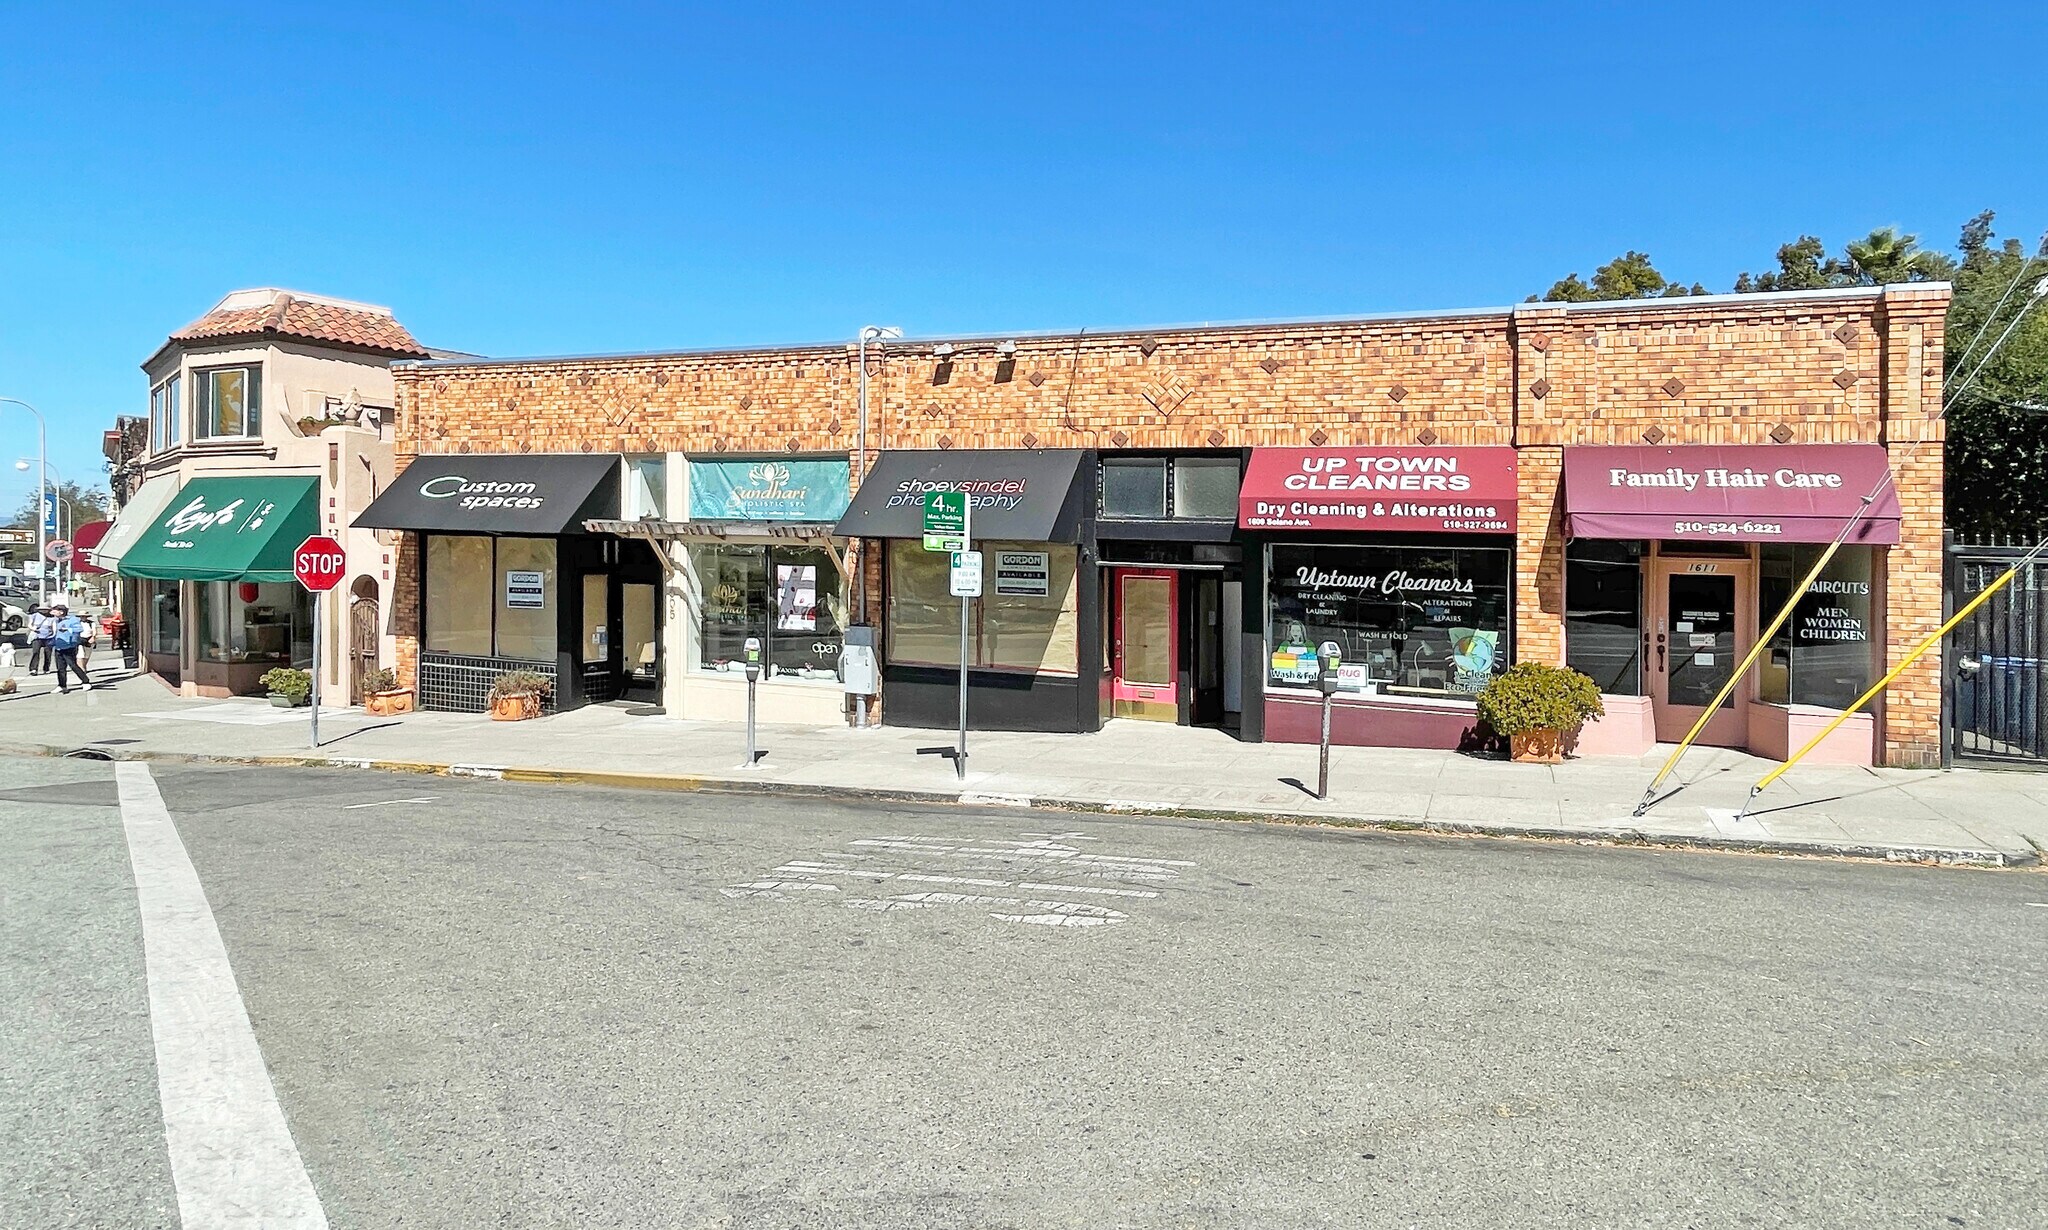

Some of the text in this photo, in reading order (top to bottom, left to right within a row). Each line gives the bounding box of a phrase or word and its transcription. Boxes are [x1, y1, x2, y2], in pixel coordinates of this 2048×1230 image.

[1302, 457, 1457, 473] UP TOWN
[1284, 474, 1472, 492] CLEANERS
[1609, 468, 1843, 492] Family Hair Care
[420, 476, 537, 498] Custom
[459, 496, 544, 510] spaces
[885, 493, 1022, 511] phoaphy
[931, 494, 959, 513] 4 hr.
[1256, 502, 1497, 519] Dry Cleaning & Alterations
[941, 514, 963, 523] Parking
[1674, 521, 1782, 535] 510-524-6221
[297, 552, 344, 575] STOP
[953, 554, 961, 567] 4
[1003, 555, 1041, 565] GORDON
[1689, 564, 1716, 572] 1611
[1296, 566, 1474, 595] Uptown Cleaners
[1805, 580, 1870, 595] AIRCUTS
[1297, 592, 1347, 602] DRY CLEANING
[1422, 600, 1473, 608] ALTERATIONS
[1305, 608, 1339, 616] LAUNDRY
[1816, 607, 1849, 617] MEN
[1804, 617, 1862, 629] WOMEN
[1358, 631, 1380, 639] WASH
[1389, 632, 1409, 640] FOLD
[1800, 628, 1867, 640] CHILDREN
[811, 641, 839, 660] open
[1271, 669, 1317, 680] Wash & Fol
[1338, 668, 1361, 678] RUG
